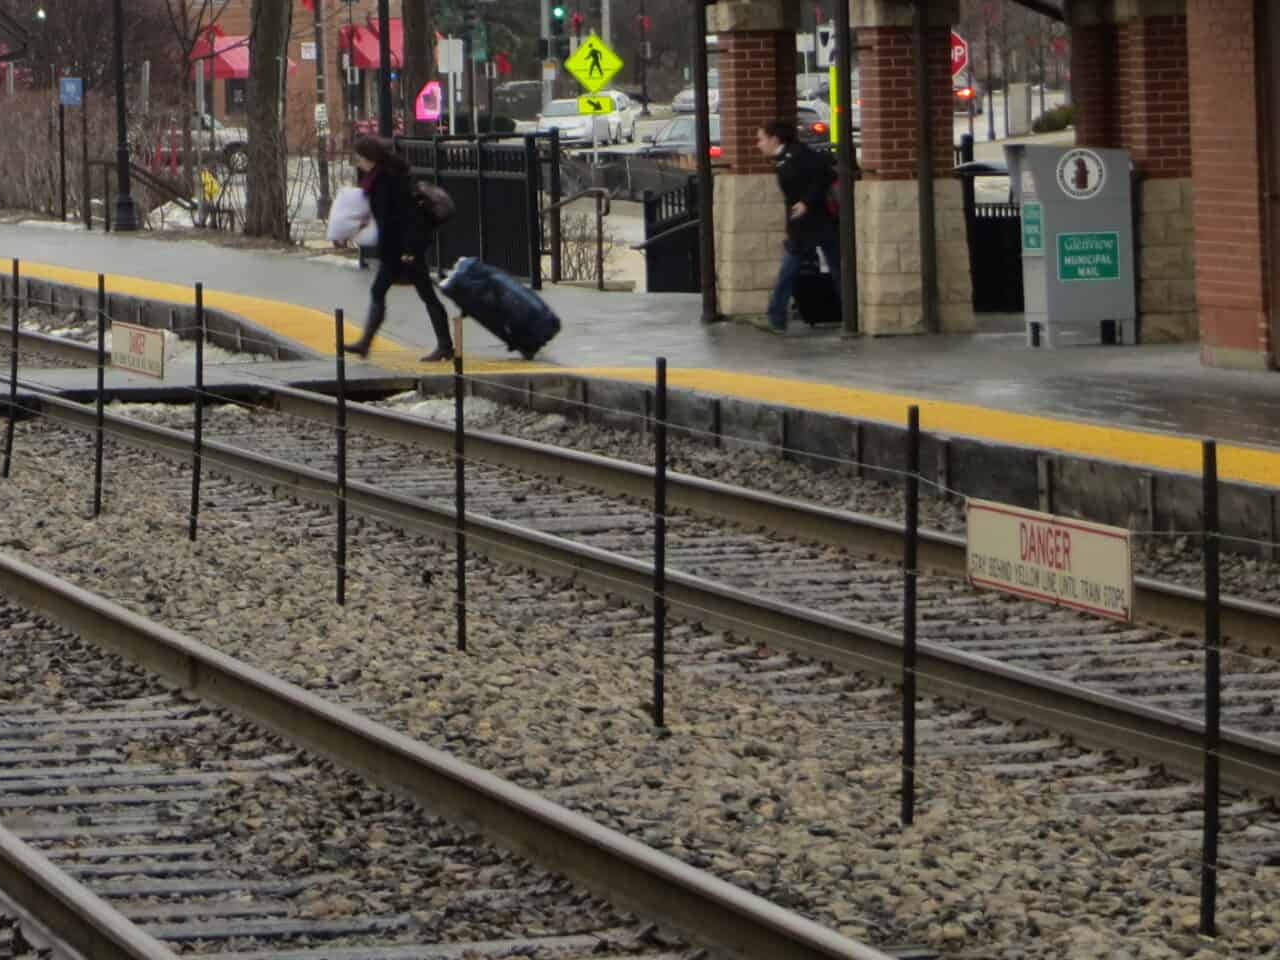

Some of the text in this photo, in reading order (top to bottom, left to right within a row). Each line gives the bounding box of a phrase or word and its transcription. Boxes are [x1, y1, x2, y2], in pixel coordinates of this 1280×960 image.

[1064, 237, 1113, 250] Glenview
[1064, 254, 1113, 265] MUNICIPAL
[1077, 266, 1100, 277] MAIL
[1020, 523, 1071, 570] DANGER
[1015, 561, 1040, 588] YELLOW
[1041, 570, 1056, 593] LINE
[1059, 574, 1078, 598] UNTIL
[1080, 580, 1101, 602] TRAIN
